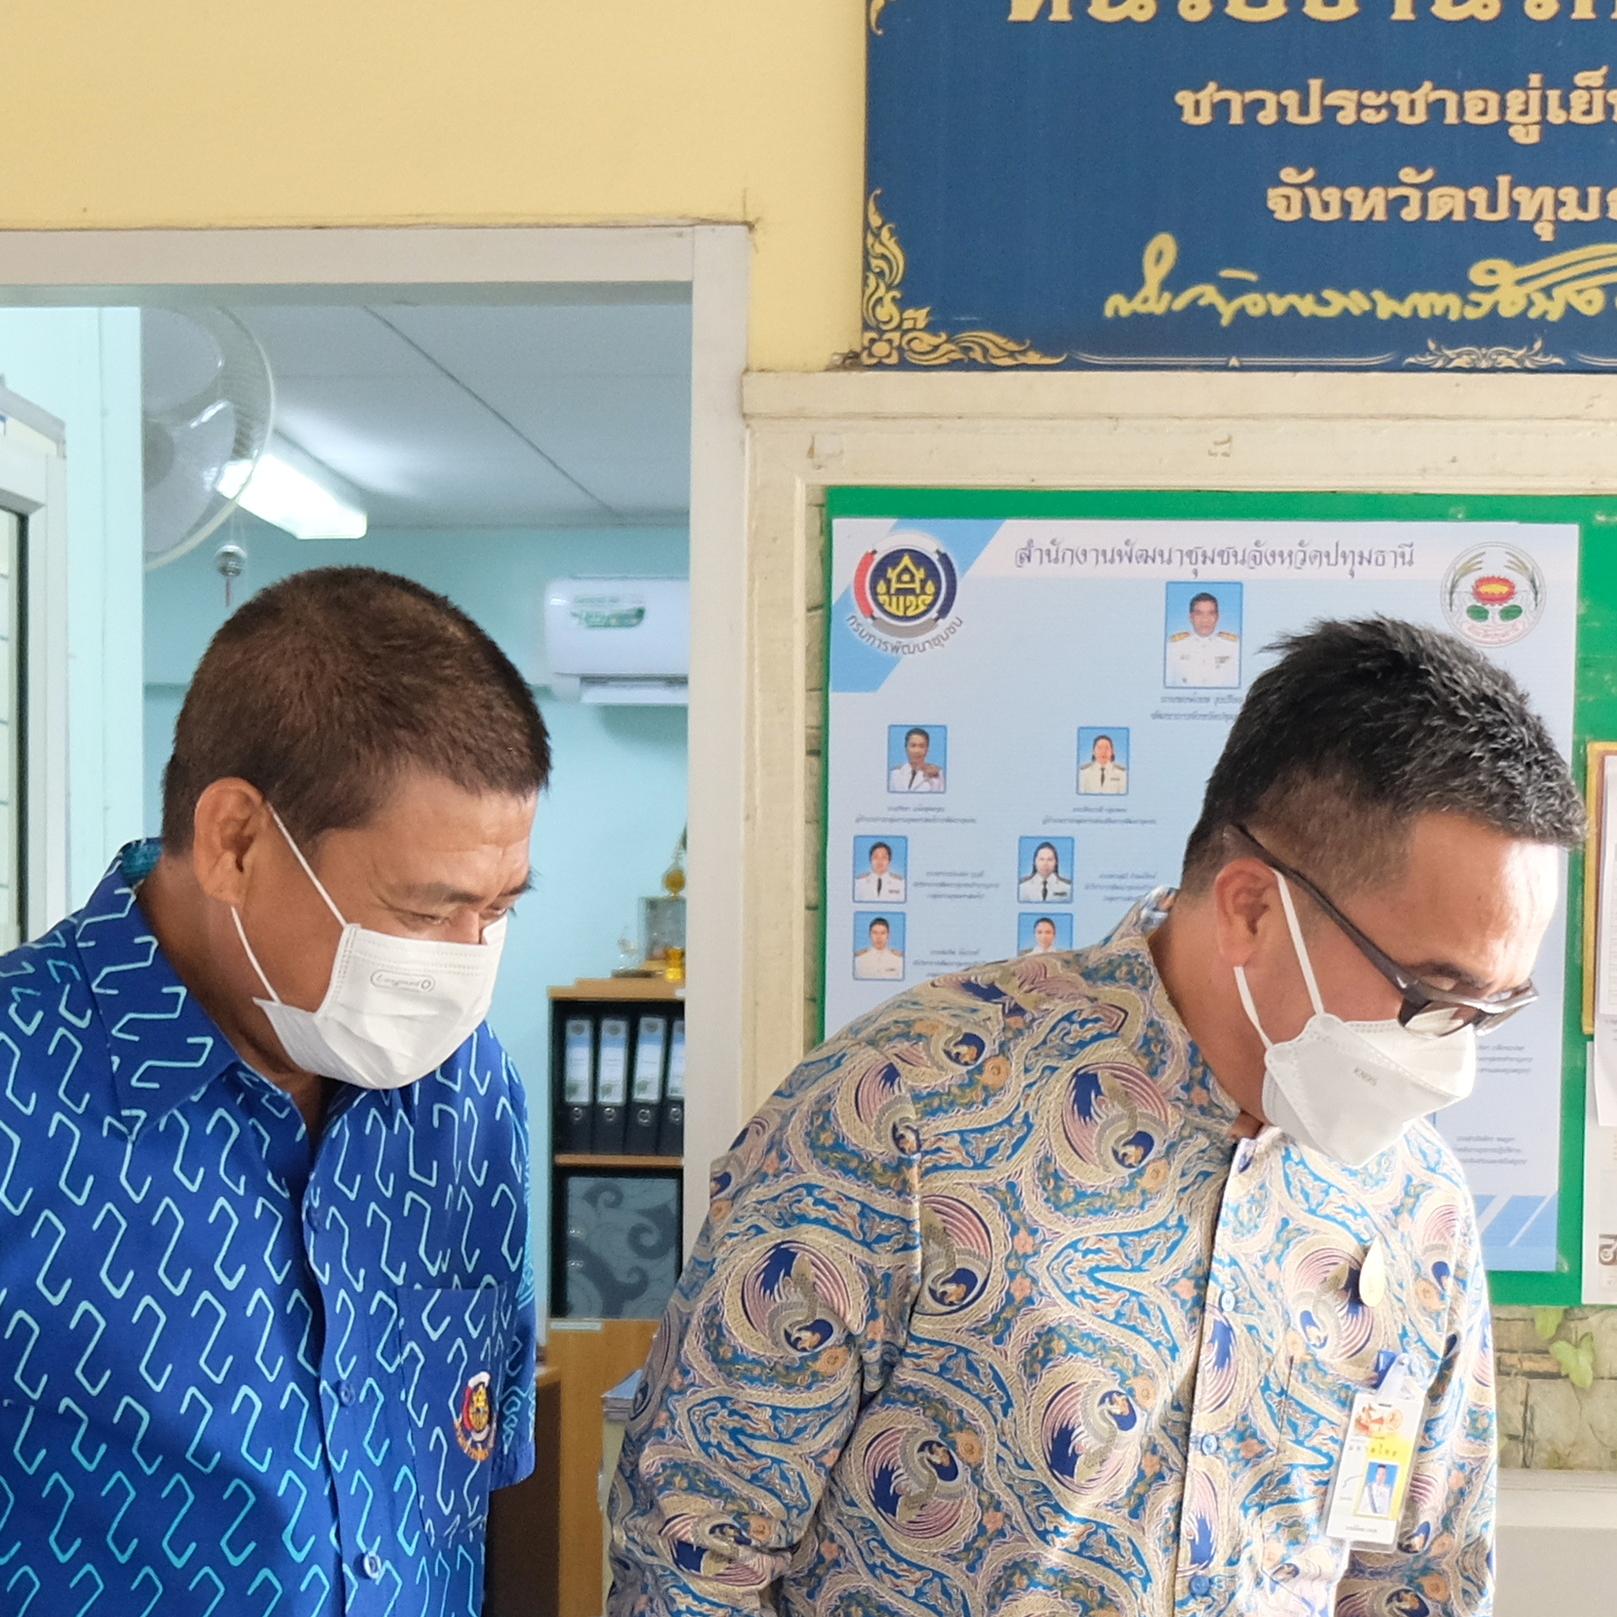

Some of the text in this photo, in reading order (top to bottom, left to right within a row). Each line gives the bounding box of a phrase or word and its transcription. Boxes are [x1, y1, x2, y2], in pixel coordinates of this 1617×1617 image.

[1014, 538, 1415, 578] สำนักงานพัฒนาชุมชนจังหวัดปทุมธานี
[845, 613, 964, 655] กรมการพัฒนาชุมชน
